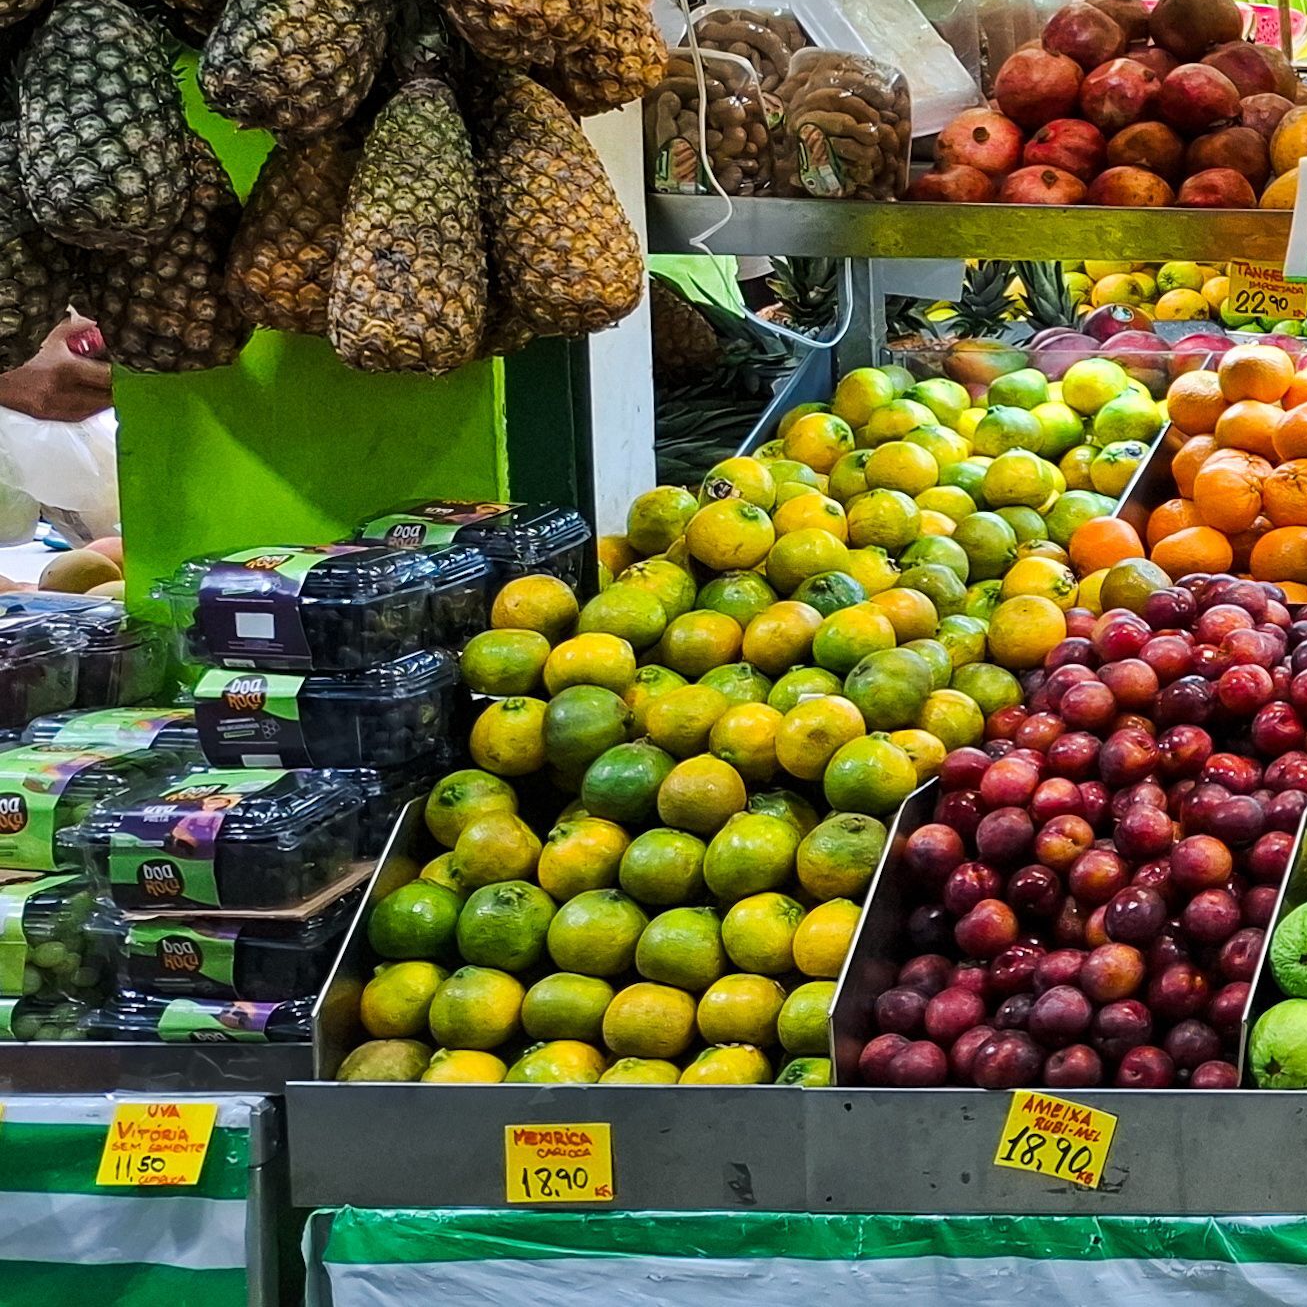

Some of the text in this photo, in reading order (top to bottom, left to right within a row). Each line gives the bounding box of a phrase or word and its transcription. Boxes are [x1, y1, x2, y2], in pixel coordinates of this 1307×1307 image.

[148, 1104, 180, 1119] UVA
[1022, 1094, 1092, 1127] AMEIXA
[1034, 1116, 1101, 1143] RUBI-MEL
[111, 1142, 142, 1152] SEM
[536, 1147, 592, 1159] CARIOCA
[1000, 1125, 1092, 1174] 18,90
